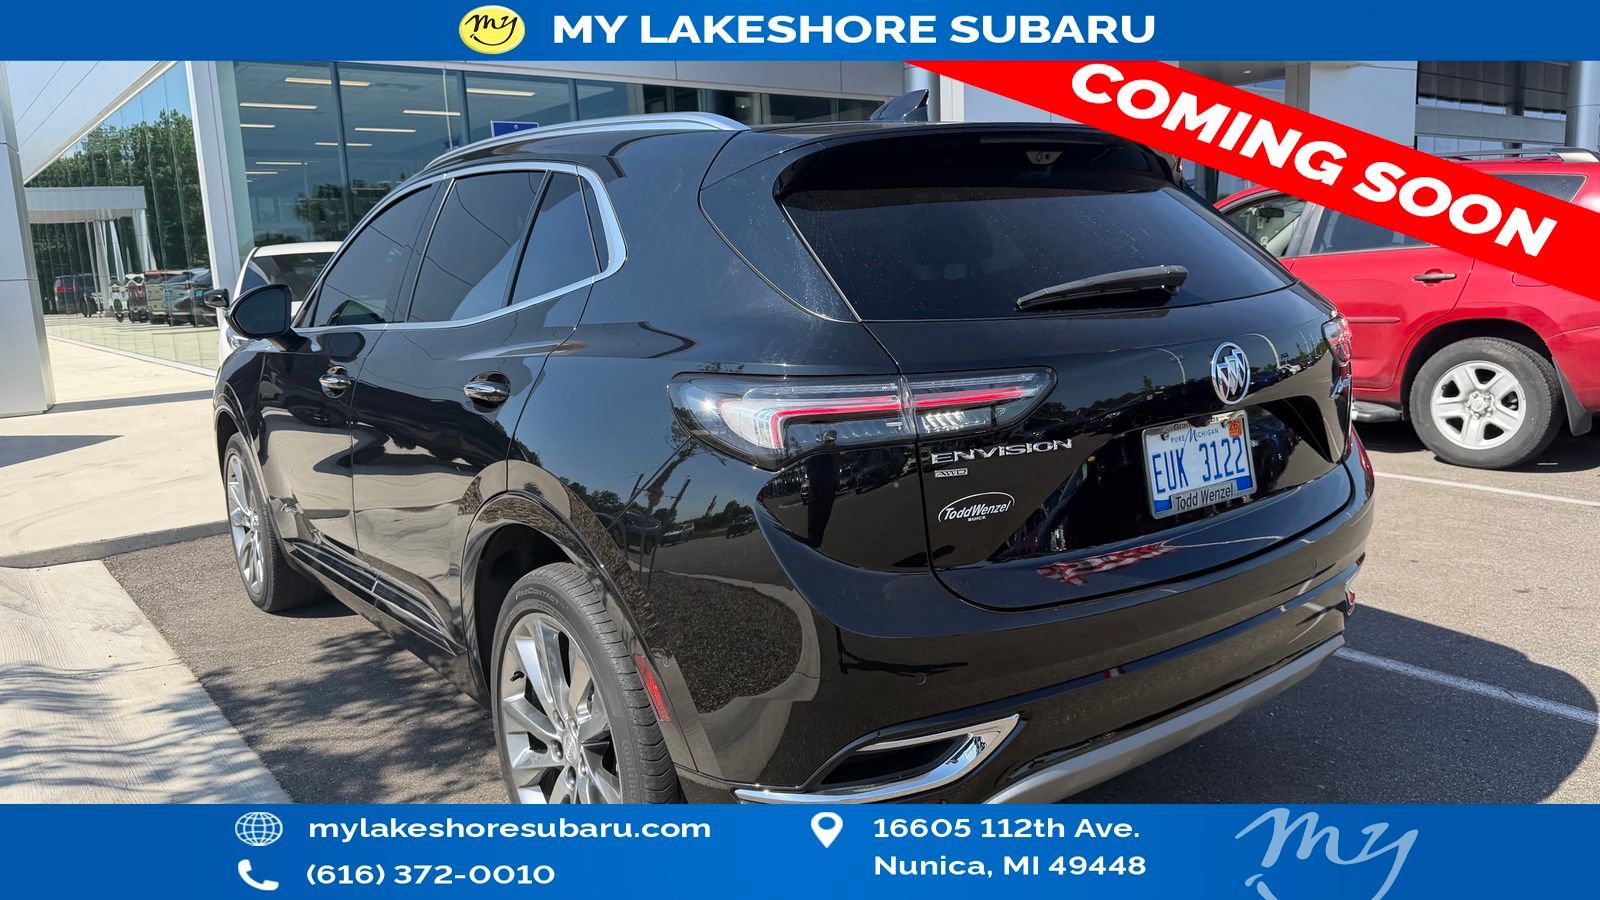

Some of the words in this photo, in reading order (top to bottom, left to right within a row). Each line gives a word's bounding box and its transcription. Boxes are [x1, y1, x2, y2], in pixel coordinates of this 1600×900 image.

[931, 438, 1073, 465] ENVISION
[1170, 434, 1185, 444] PURE
[934, 468, 969, 478] AWD
[1151, 448, 1189, 494] EUK
[1198, 437, 1245, 482] 3122
[1175, 491, 1198, 511] Todd
[1200, 483, 1234, 505] Wenzel
